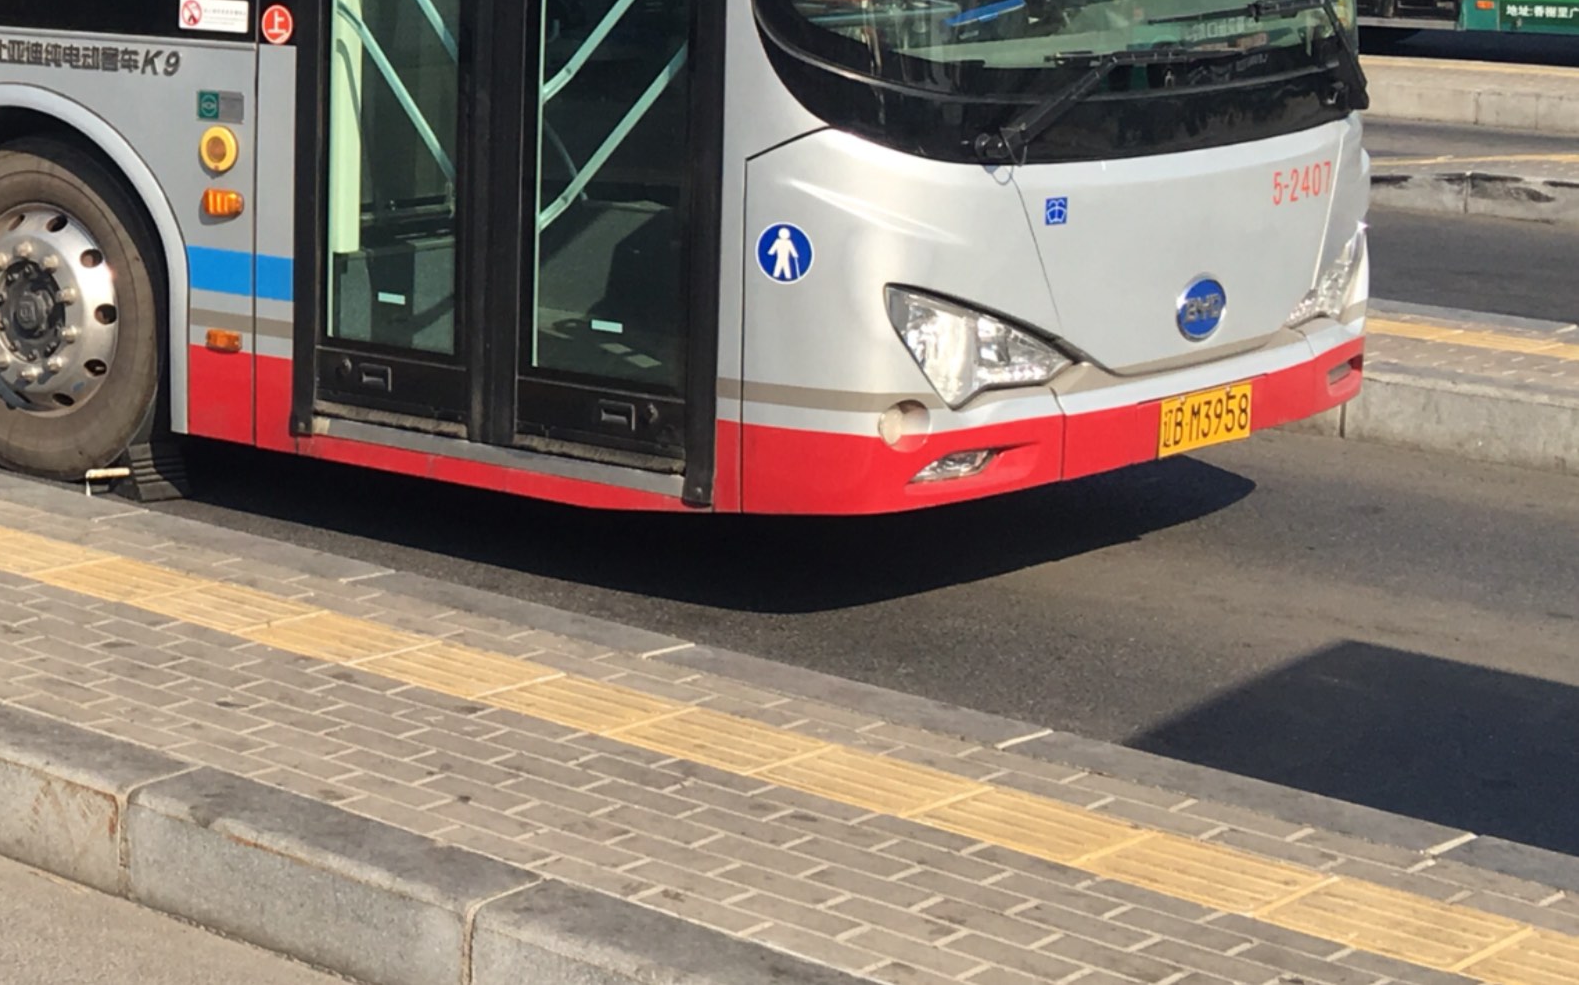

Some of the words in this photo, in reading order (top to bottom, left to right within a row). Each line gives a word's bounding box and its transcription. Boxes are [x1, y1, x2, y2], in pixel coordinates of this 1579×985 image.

[265, 8, 288, 36] 上
[1272, 160, 1331, 206] 5-2407
[1184, 293, 1222, 323] BYD
